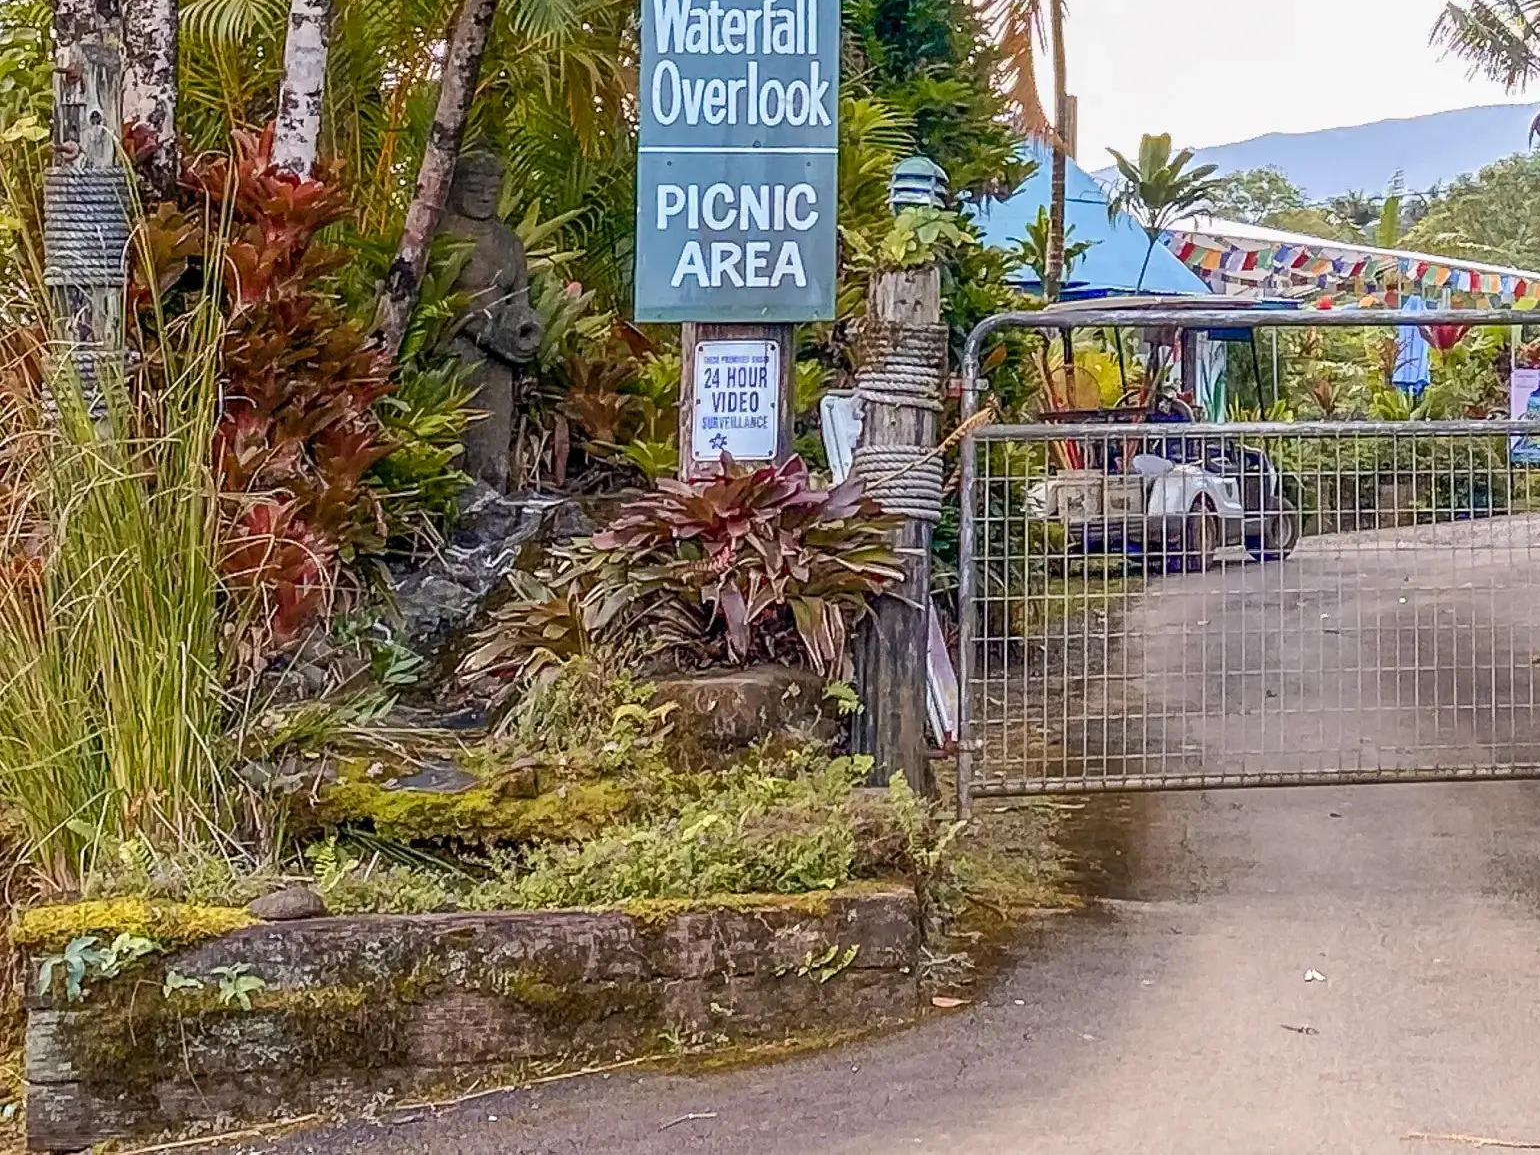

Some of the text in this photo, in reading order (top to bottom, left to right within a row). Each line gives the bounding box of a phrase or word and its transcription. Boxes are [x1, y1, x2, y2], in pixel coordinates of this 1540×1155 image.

[652, 59, 832, 127] Overlook
[656, 183, 819, 231] PICNIC
[670, 241, 807, 288] AREA
[704, 366, 768, 389] 24 HOUR
[711, 391, 760, 413] VIDEO
[702, 415, 768, 430] SURVEILLANCE
